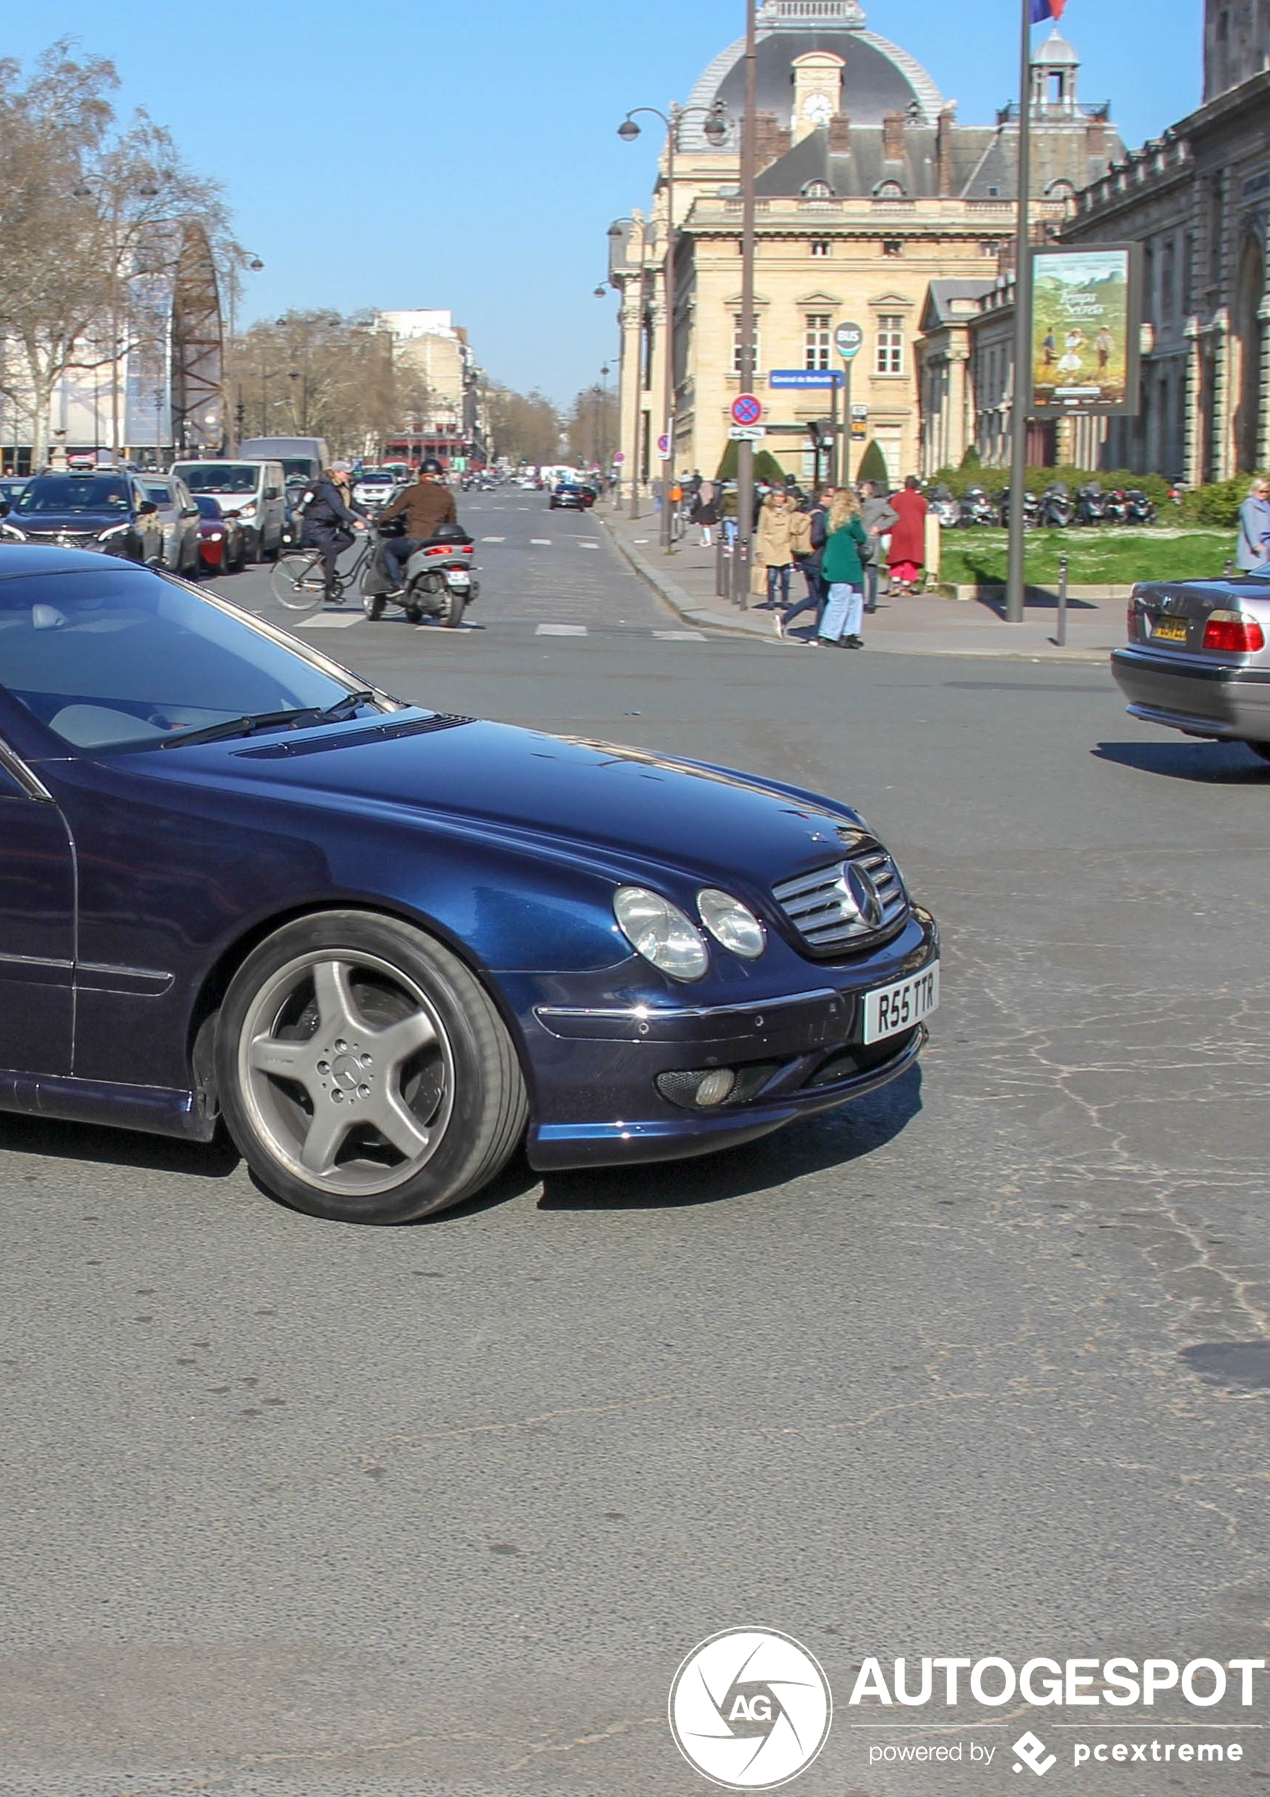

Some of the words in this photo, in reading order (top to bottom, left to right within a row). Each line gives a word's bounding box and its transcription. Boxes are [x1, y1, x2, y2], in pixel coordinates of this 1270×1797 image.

[837, 330, 859, 341] BUS
[878, 985, 910, 1033] R55
[914, 972, 934, 1017] TTR
